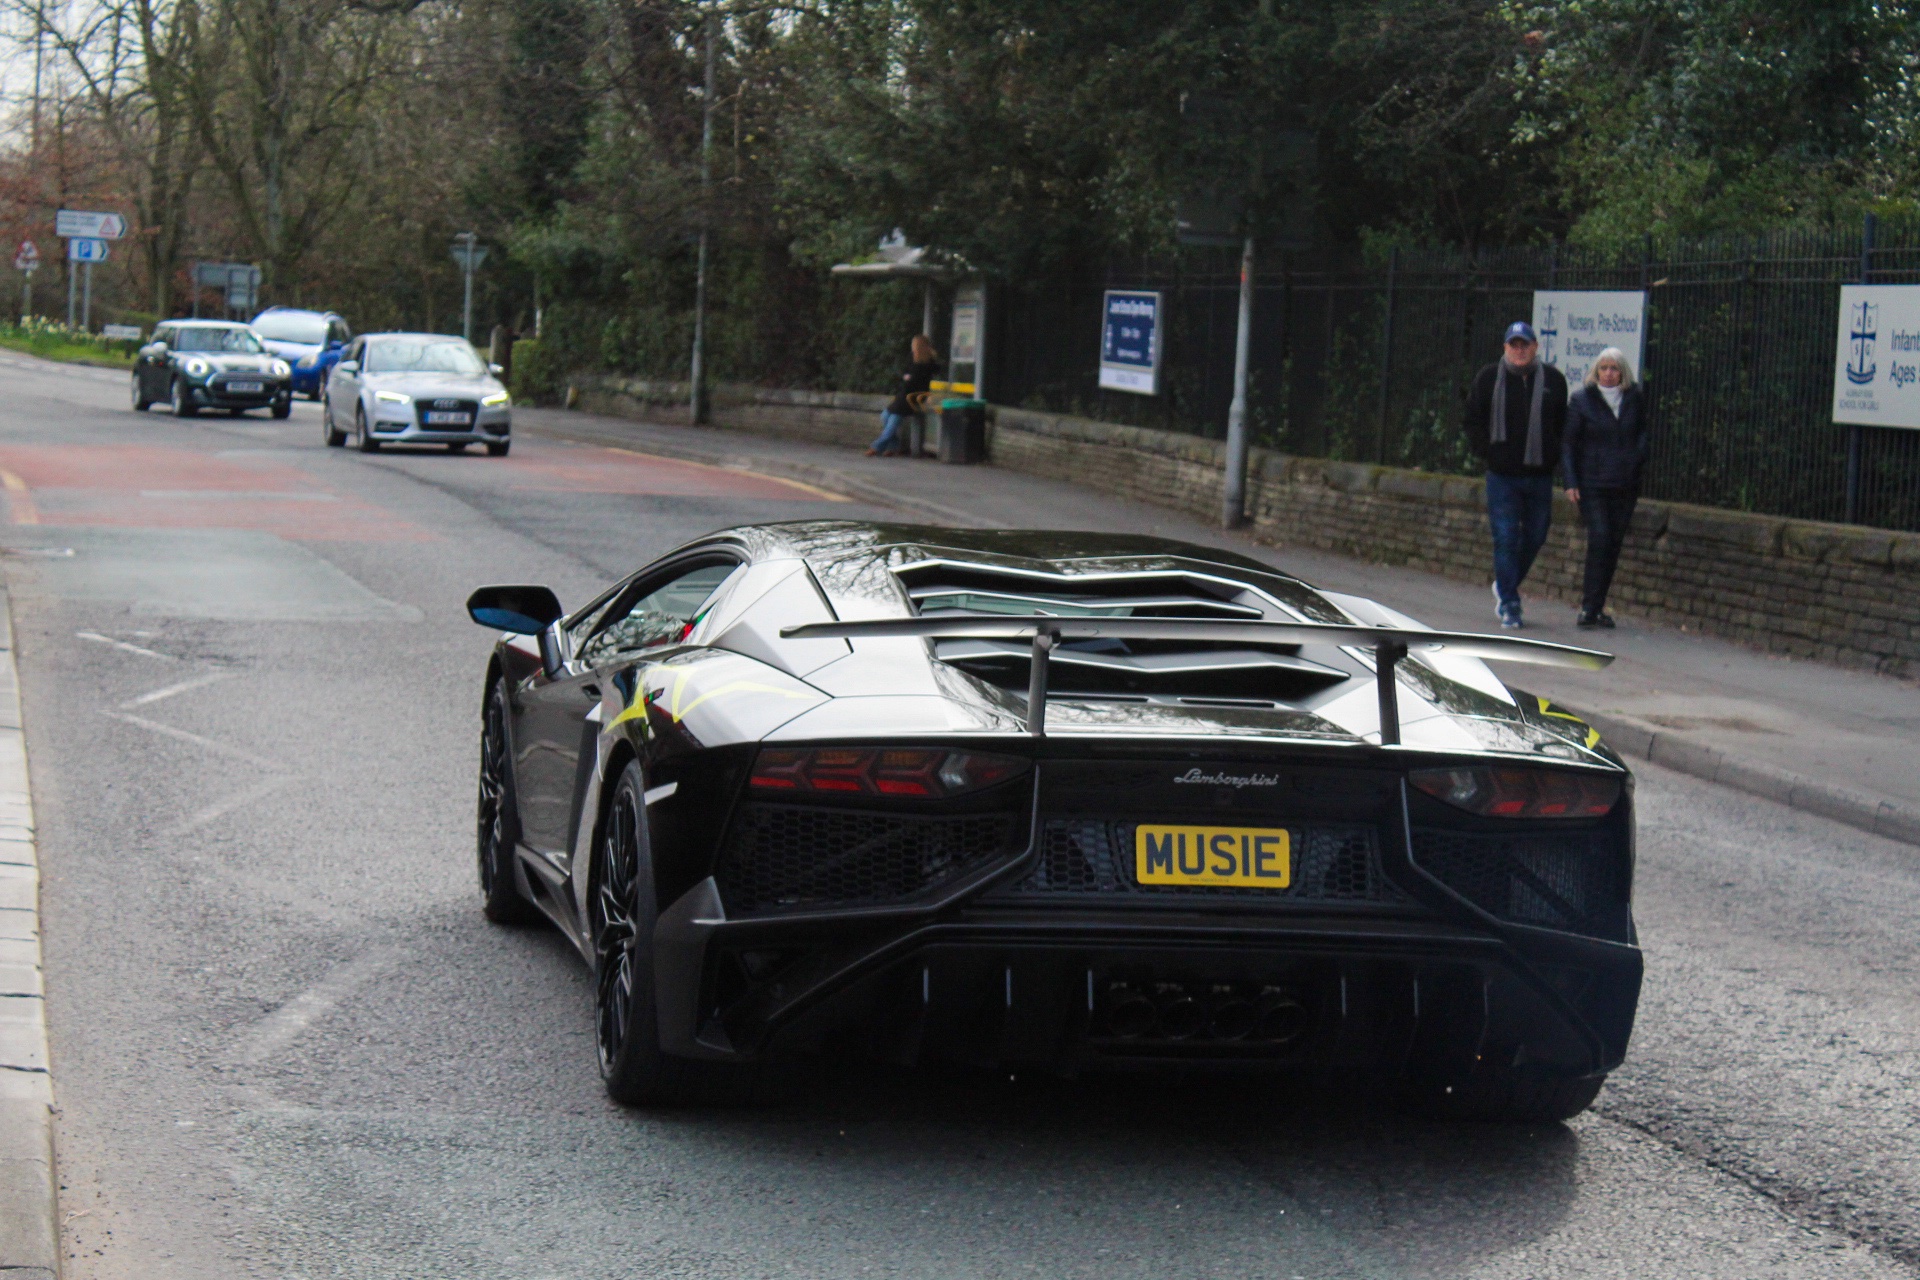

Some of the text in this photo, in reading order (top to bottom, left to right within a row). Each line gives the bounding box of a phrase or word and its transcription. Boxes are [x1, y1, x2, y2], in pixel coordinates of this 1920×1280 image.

[1598, 312, 1638, 332] Pre-School
[1889, 360, 1916, 388] Ages
[1174, 768, 1279, 788] Lamborghini
